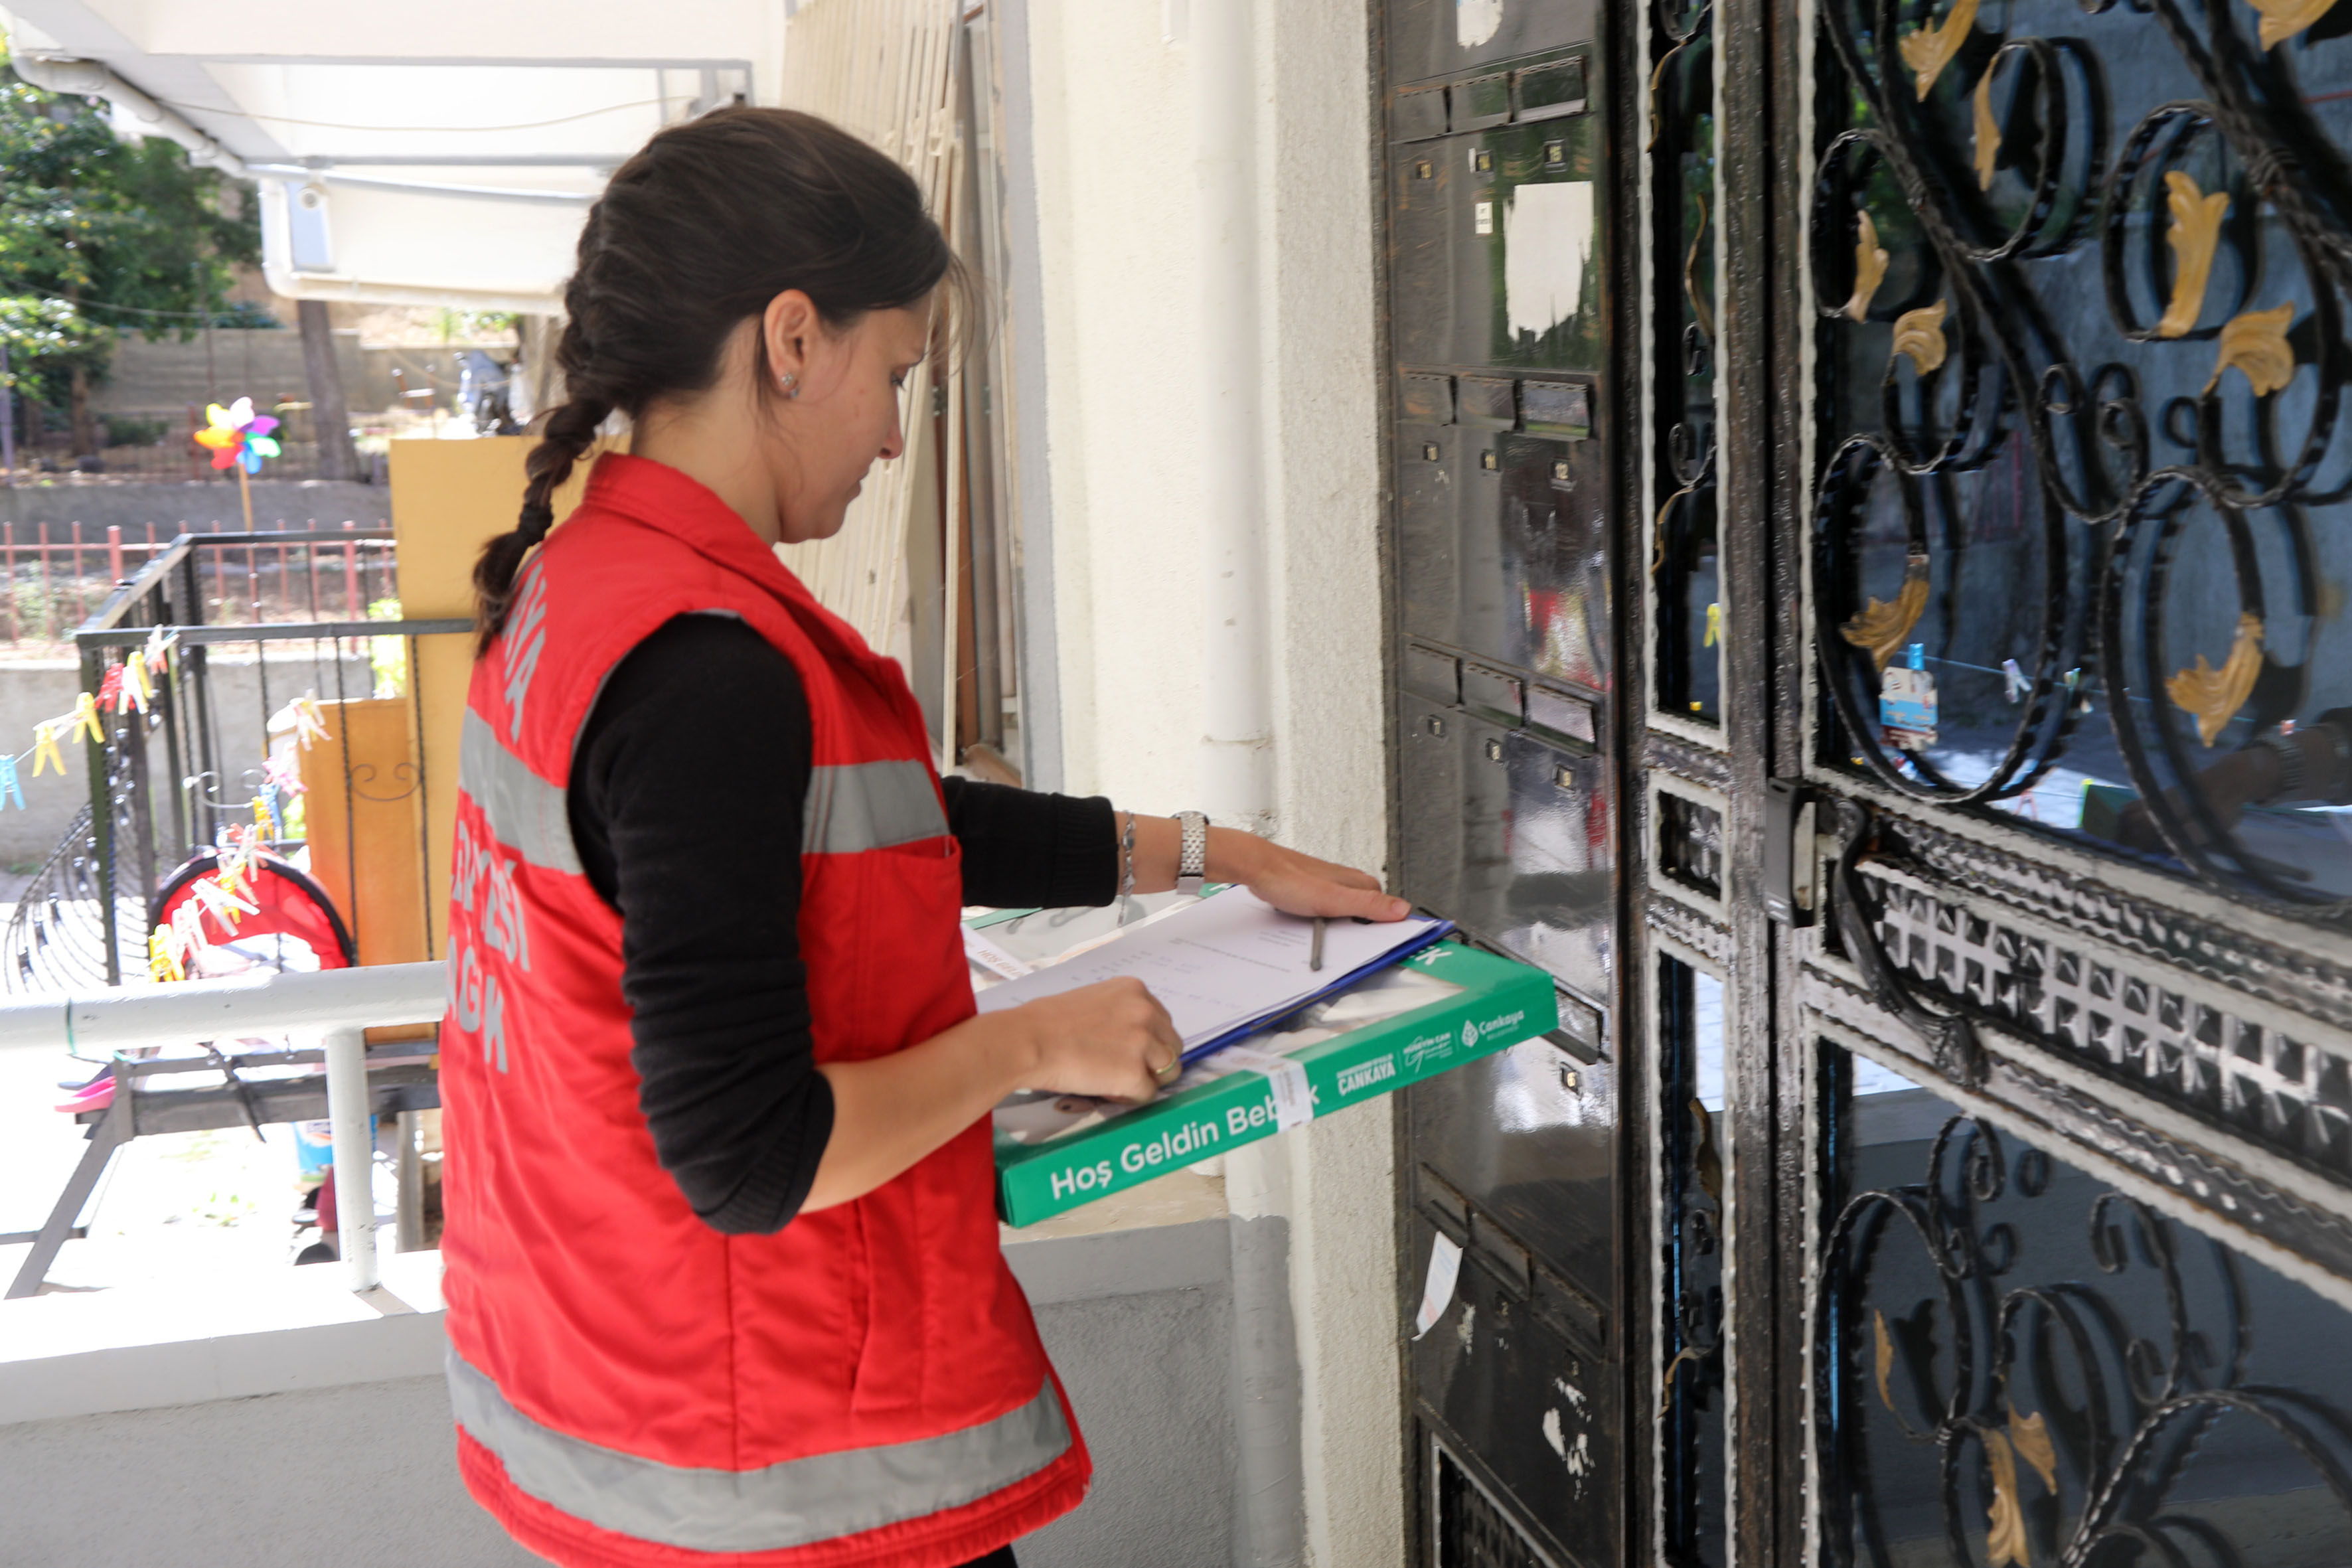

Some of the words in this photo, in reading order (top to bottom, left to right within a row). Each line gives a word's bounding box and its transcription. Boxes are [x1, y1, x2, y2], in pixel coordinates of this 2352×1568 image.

[1555, 462, 1569, 480] 12
[1050, 1160, 1113, 1200] Hoş
[1120, 1121, 1220, 1173] Geldin
